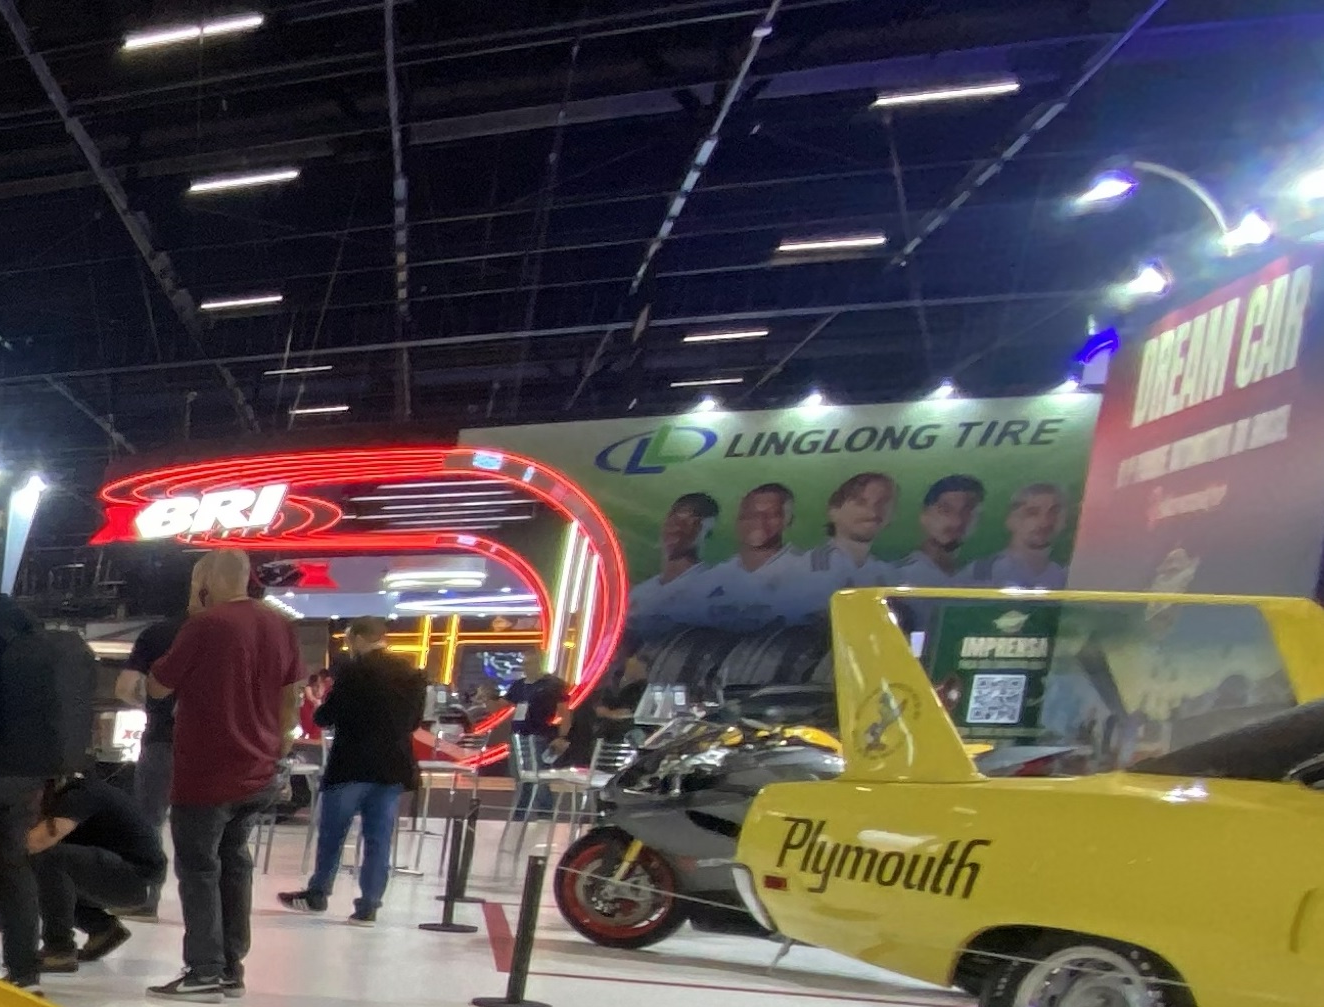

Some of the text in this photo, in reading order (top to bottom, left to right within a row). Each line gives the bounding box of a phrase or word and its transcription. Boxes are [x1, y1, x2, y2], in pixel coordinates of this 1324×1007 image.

[724, 418, 1065, 459] LINGLONG TIRE
[776, 815, 994, 901] Plymouth
